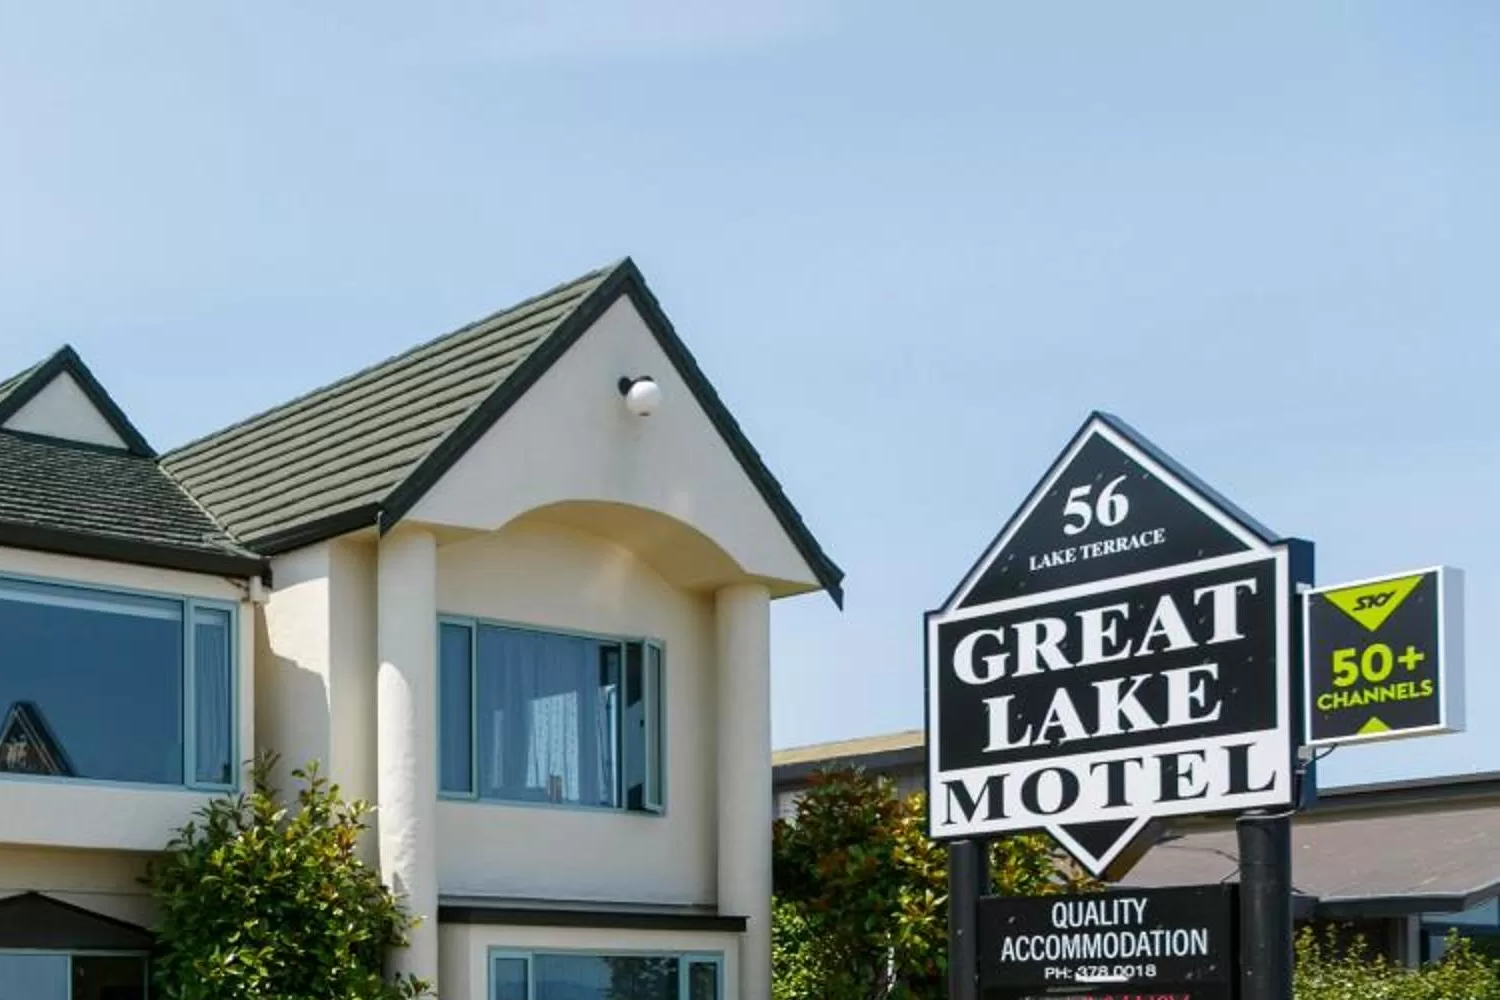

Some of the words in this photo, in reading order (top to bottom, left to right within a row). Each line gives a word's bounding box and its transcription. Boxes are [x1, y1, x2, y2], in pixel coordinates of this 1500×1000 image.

[1063, 474, 1129, 536] 56
[1029, 547, 1077, 571] LAKE
[1080, 527, 1166, 561] TERRACE
[952, 577, 1258, 686] GREAT
[1332, 643, 1424, 687] 50+
[982, 662, 1222, 754] LAKE
[1316, 679, 1433, 711] CHANNELS
[940, 742, 1277, 826] MOTEL
[1052, 898, 1148, 928] QUALITY
[1000, 928, 1207, 962] ACCOMMODATION
[1044, 967, 1073, 979] PH:
